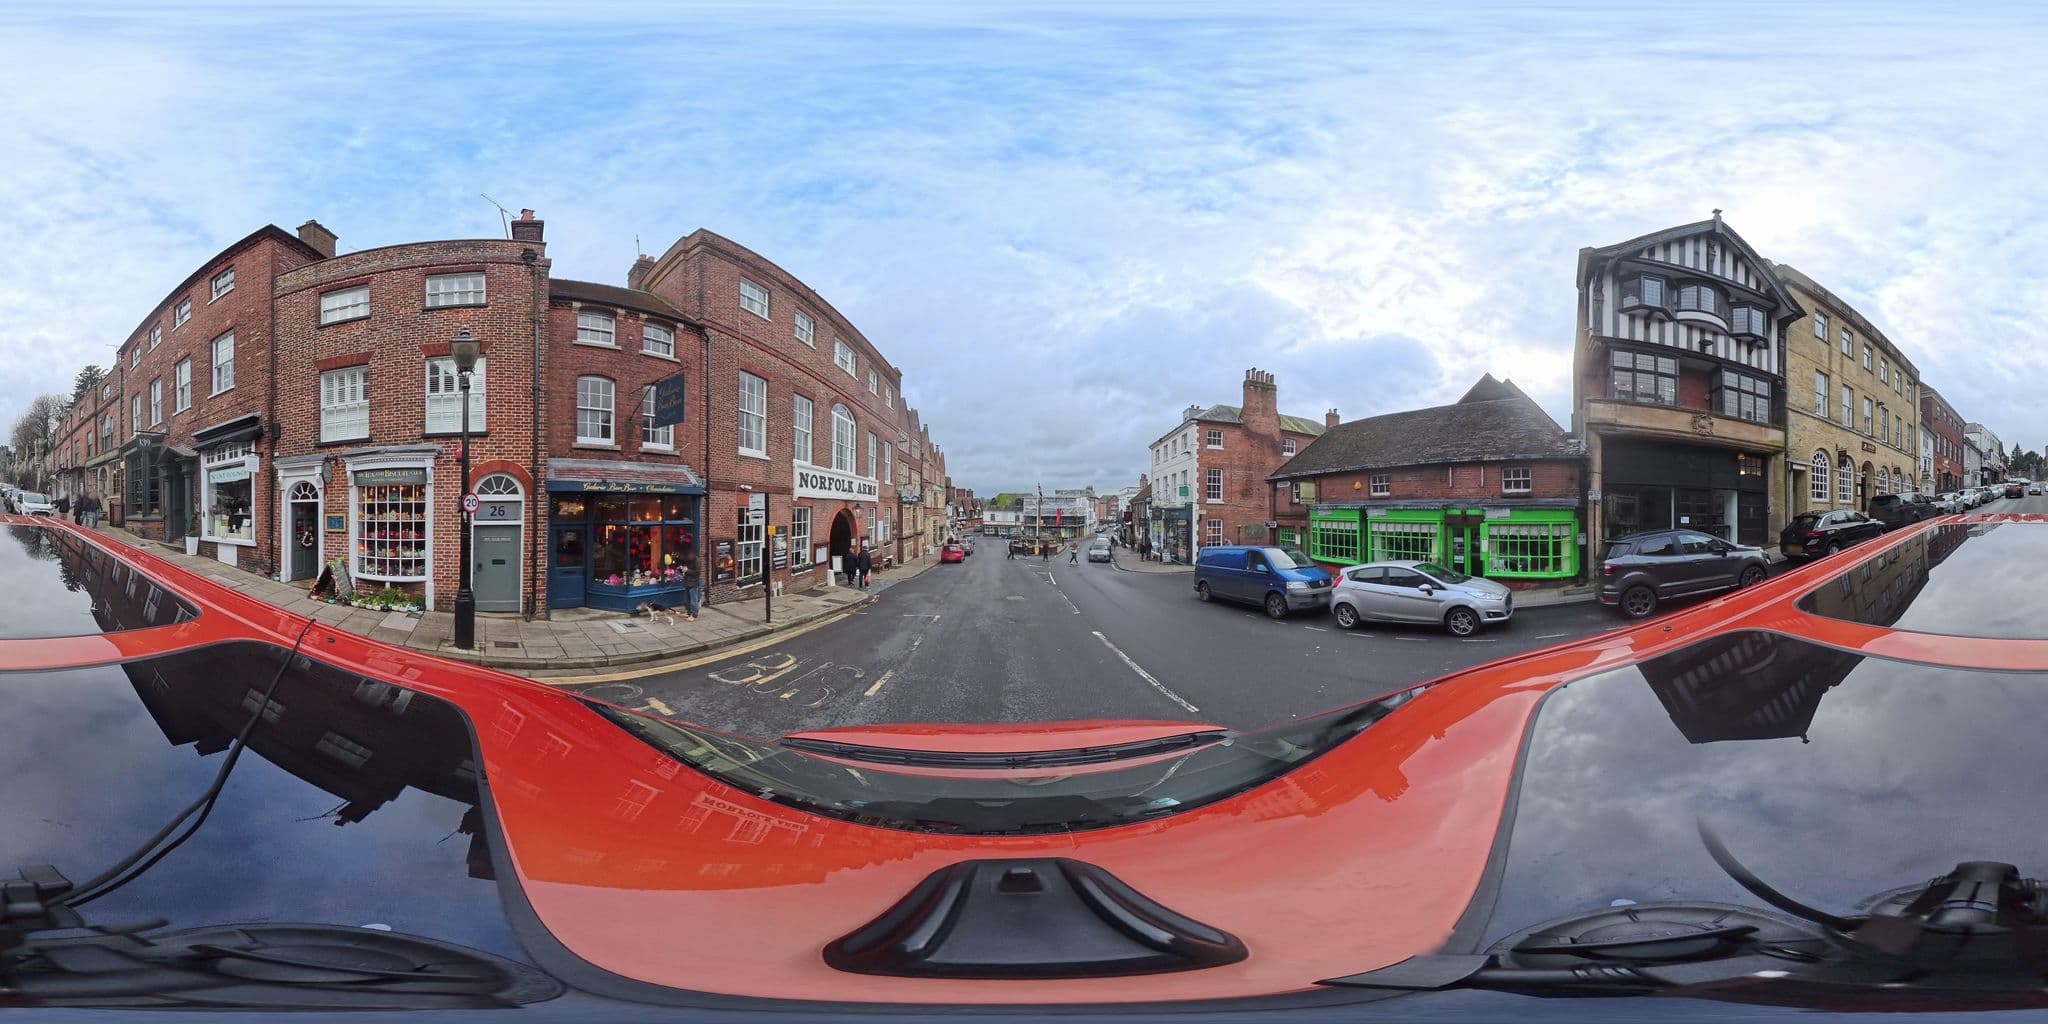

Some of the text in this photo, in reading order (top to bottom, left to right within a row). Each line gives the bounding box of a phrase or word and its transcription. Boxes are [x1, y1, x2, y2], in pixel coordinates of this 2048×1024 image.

[798, 472, 877, 496] NORFOLK ARMS
[466, 498, 477, 508] 20
[489, 505, 505, 517] 26
[708, 652, 866, 708] BUS
